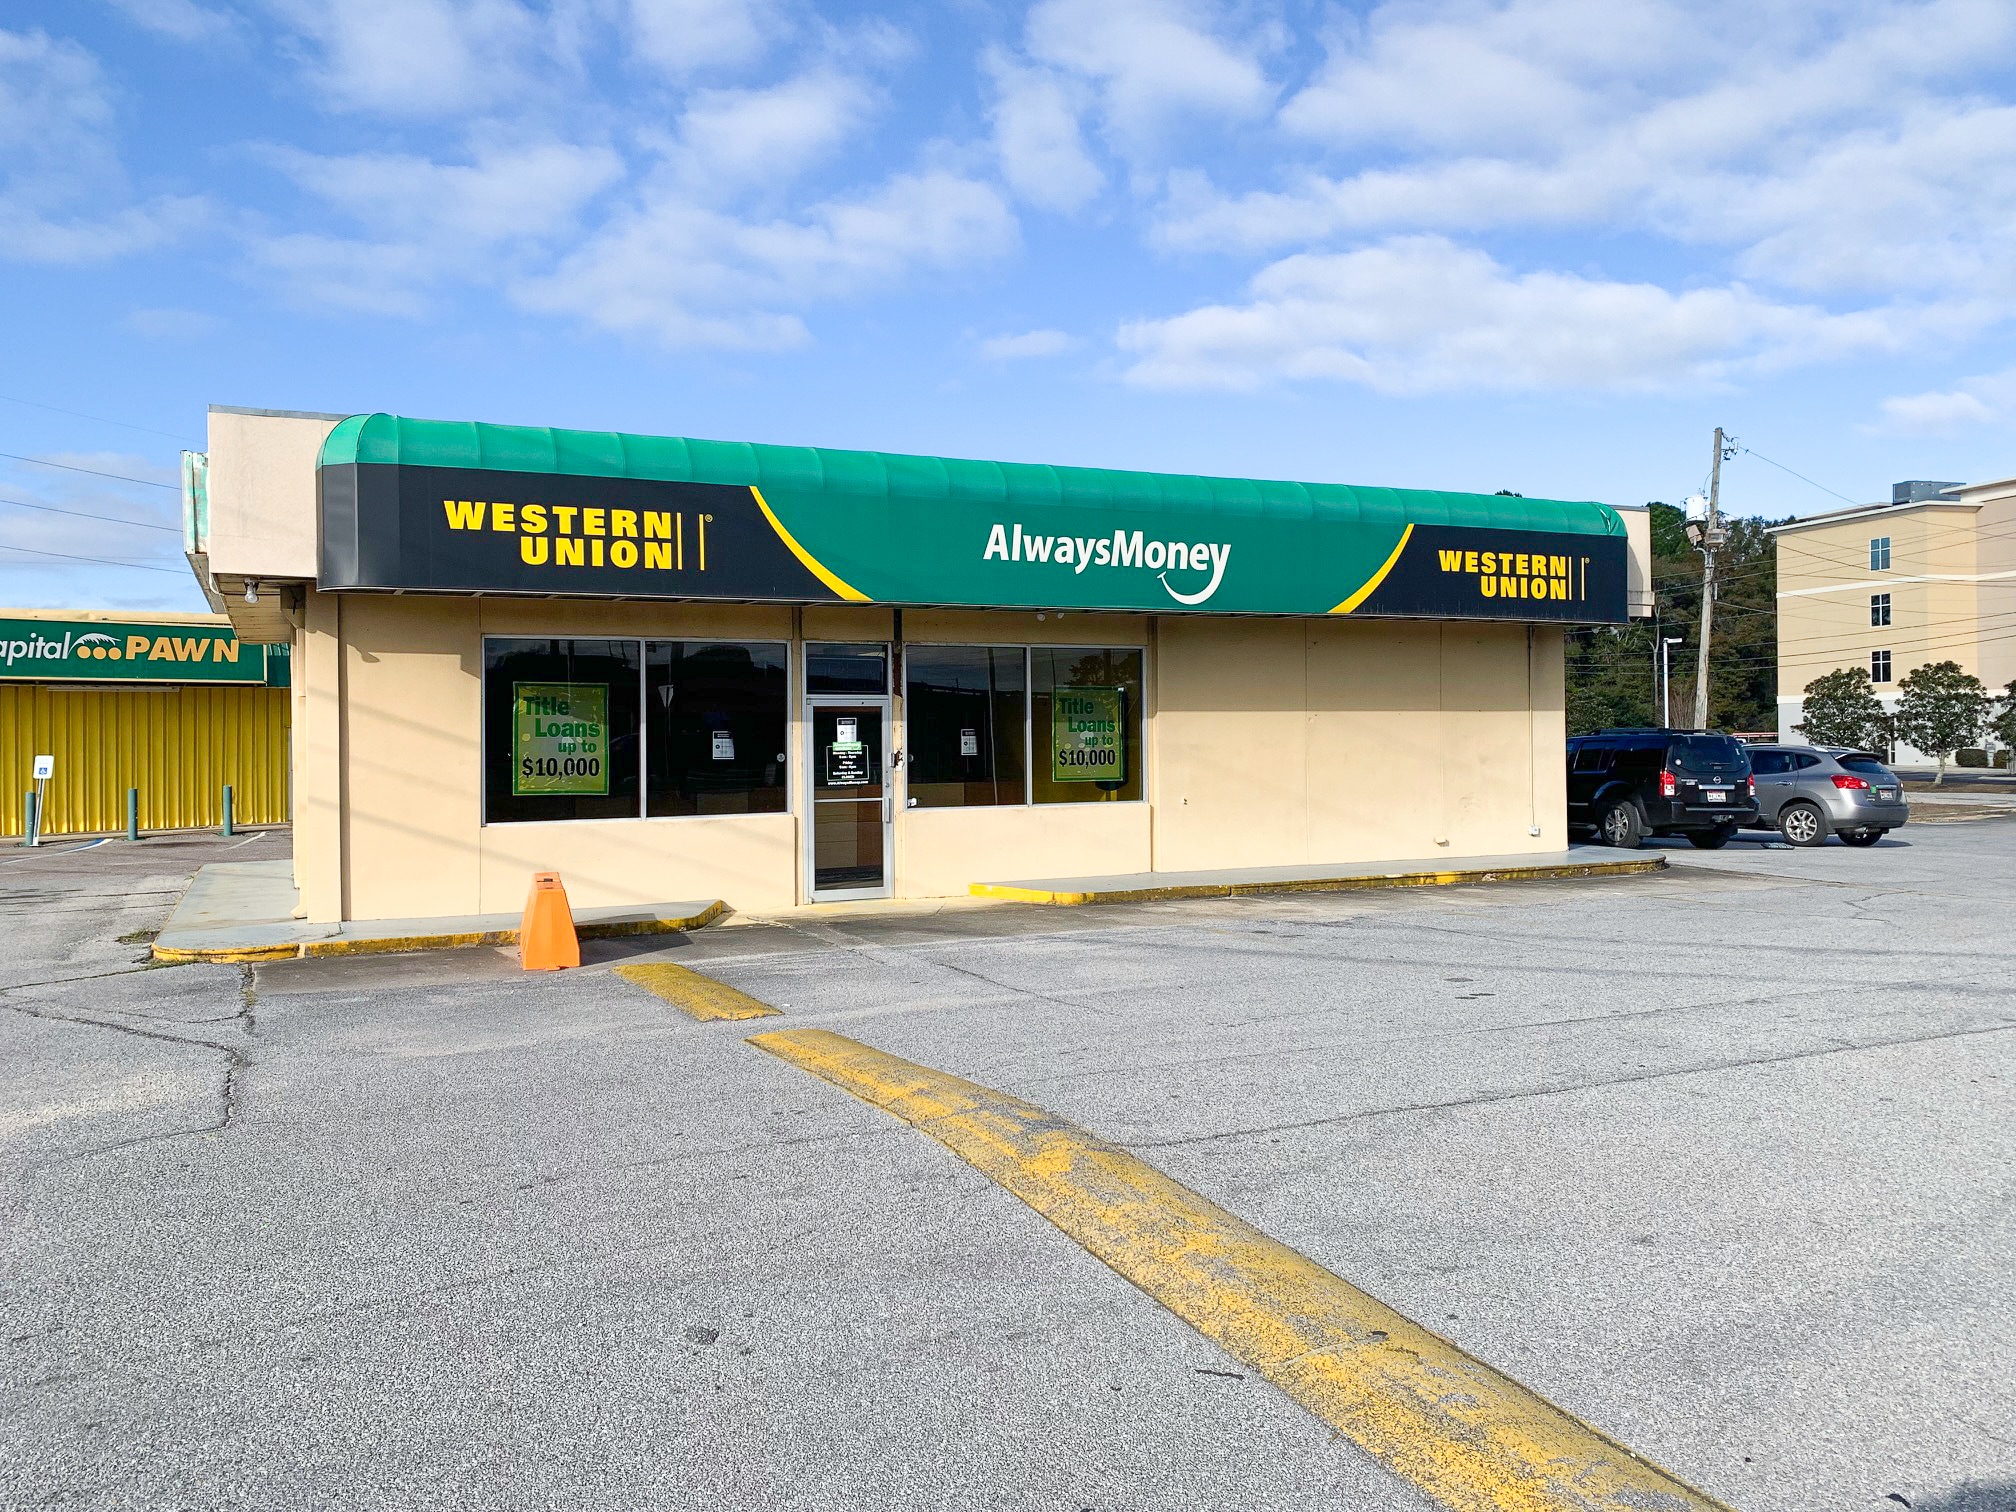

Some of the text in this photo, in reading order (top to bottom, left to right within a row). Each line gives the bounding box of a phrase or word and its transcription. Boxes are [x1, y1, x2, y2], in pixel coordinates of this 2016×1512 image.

[443, 500, 672, 540] WESTERN
[520, 536, 671, 571] UNION
[983, 523, 1232, 605] AlwaysMoney
[1438, 549, 1567, 578] WESTERN
[1480, 575, 1567, 600] UNION
[125, 635, 240, 663] PAWN
[523, 696, 570, 716] Title
[1059, 697, 1094, 715] Title
[535, 717, 601, 738] Loans
[1067, 716, 1116, 733] Loans
[557, 740, 598, 756] up to
[1084, 734, 1114, 748] up to
[522, 756, 601, 781] $10,000
[1059, 749, 1115, 769] $10,000
